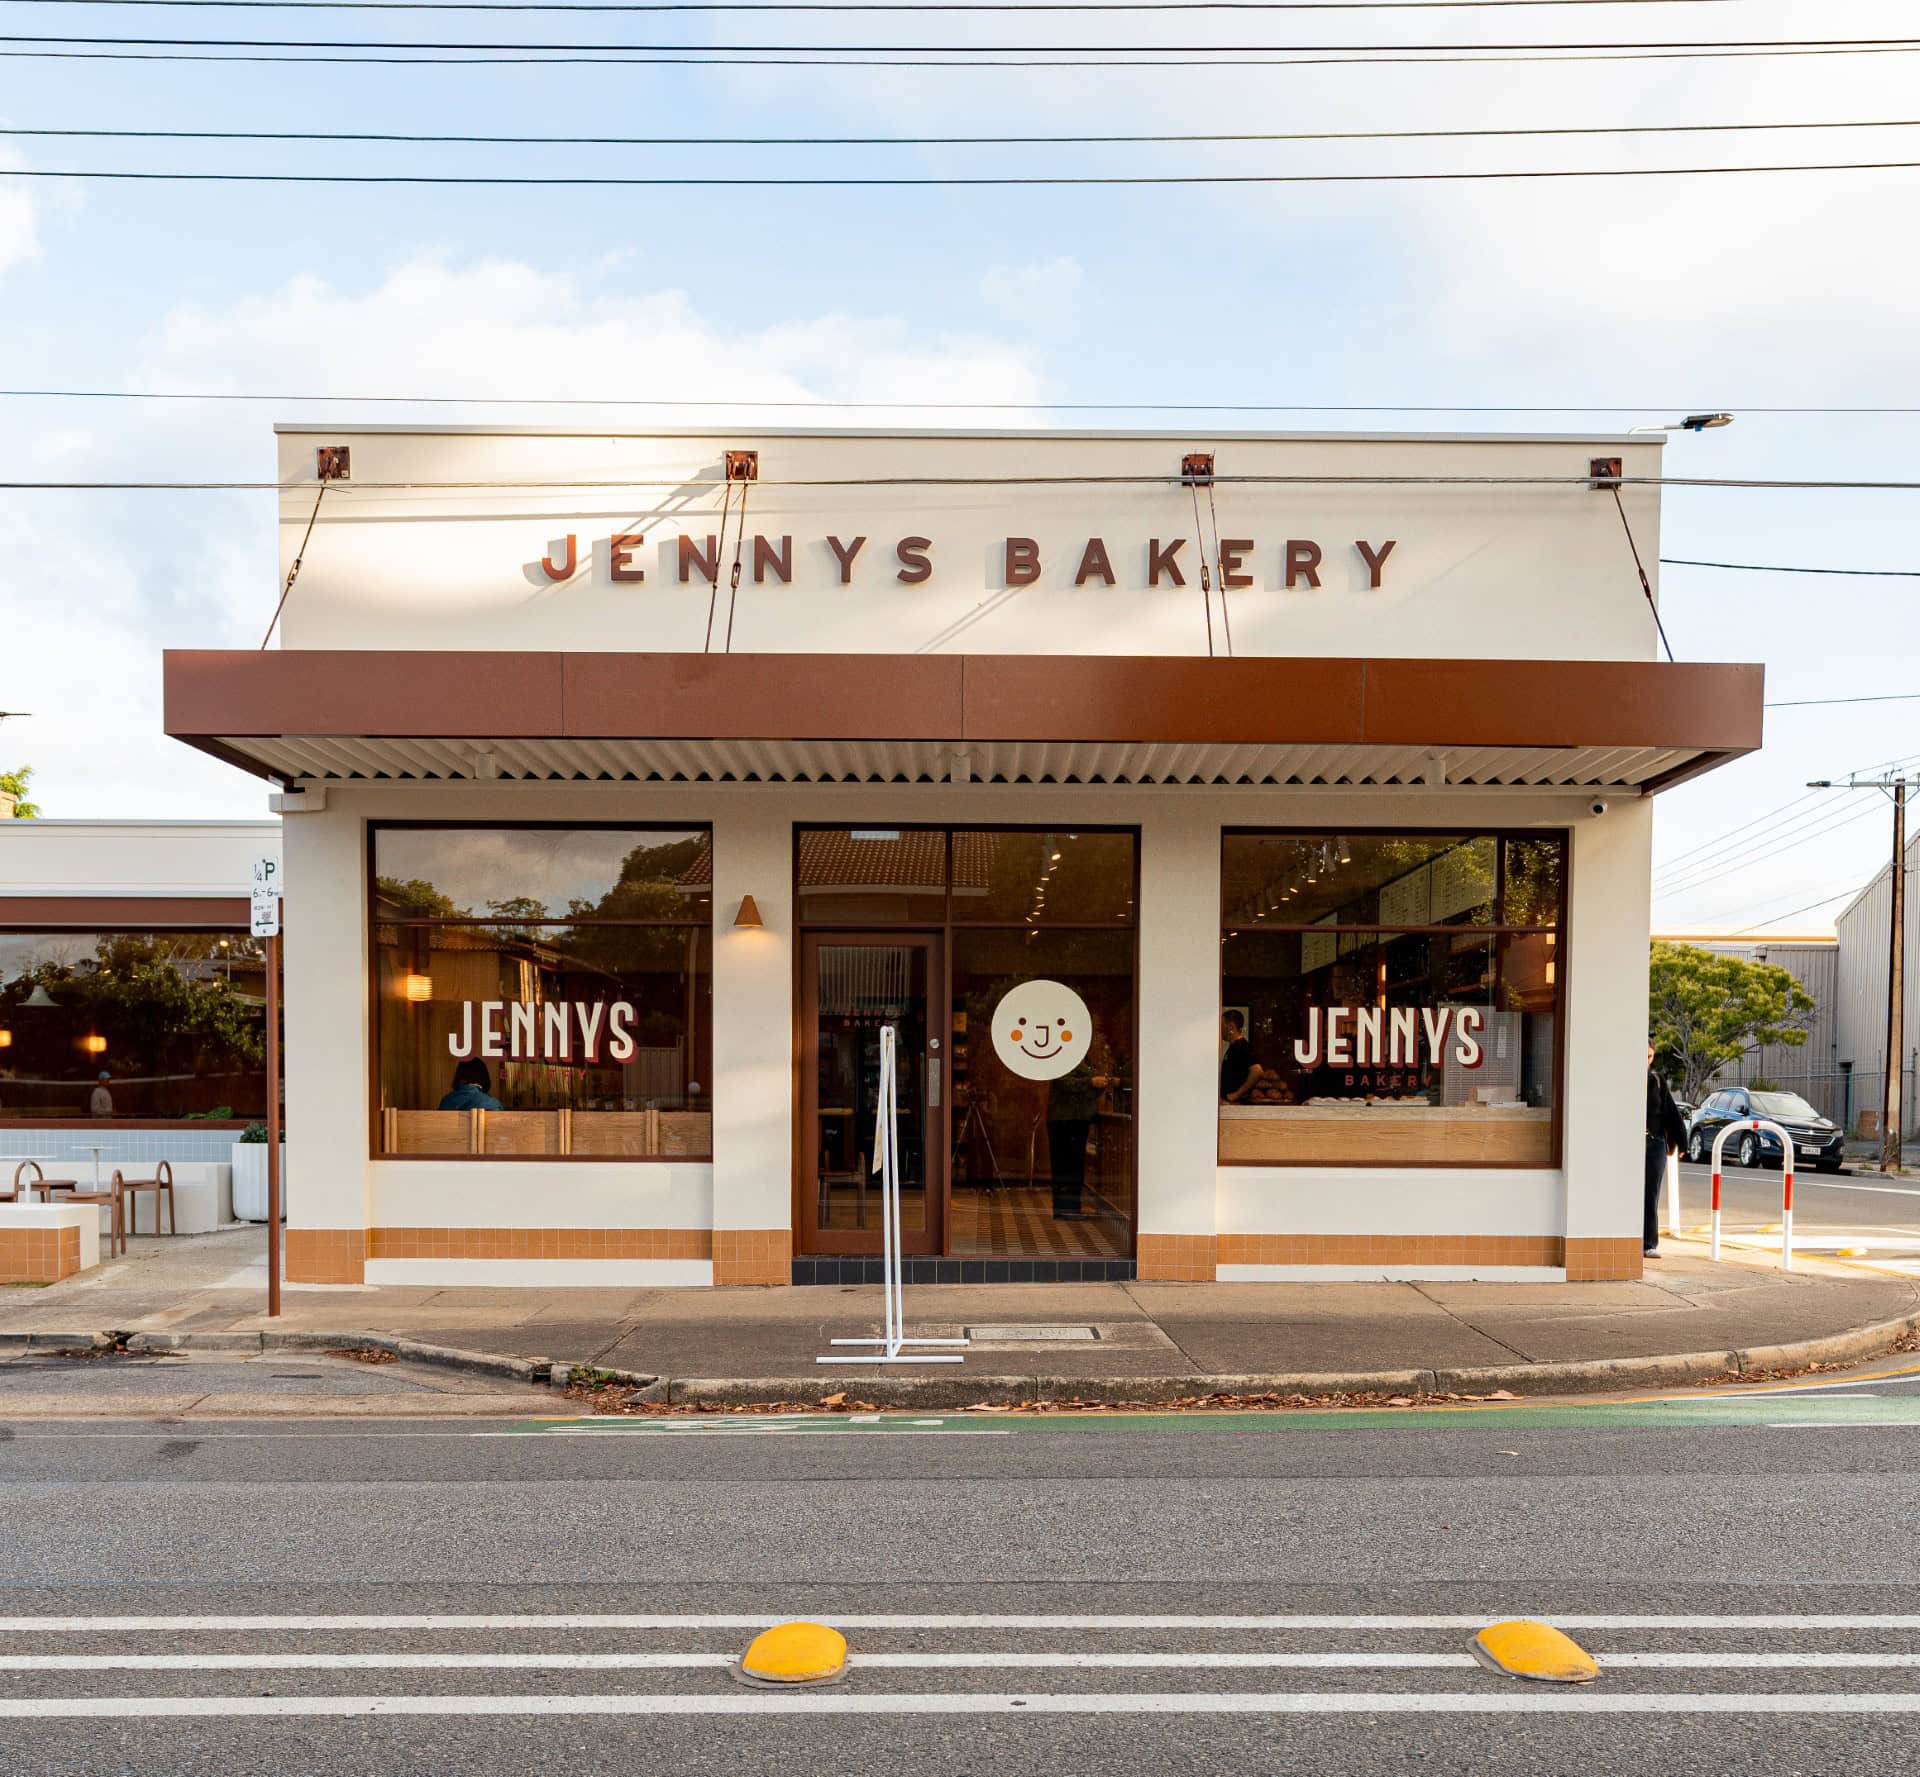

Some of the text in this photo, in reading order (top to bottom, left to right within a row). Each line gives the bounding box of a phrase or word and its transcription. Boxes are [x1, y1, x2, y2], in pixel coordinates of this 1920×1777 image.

[542, 534, 1397, 588] JENNYS BAKERY
[448, 1000, 639, 1063] JENNYS
[1294, 1006, 1485, 1068] JENNYS
[1344, 1074, 1432, 1087] BAKERY
